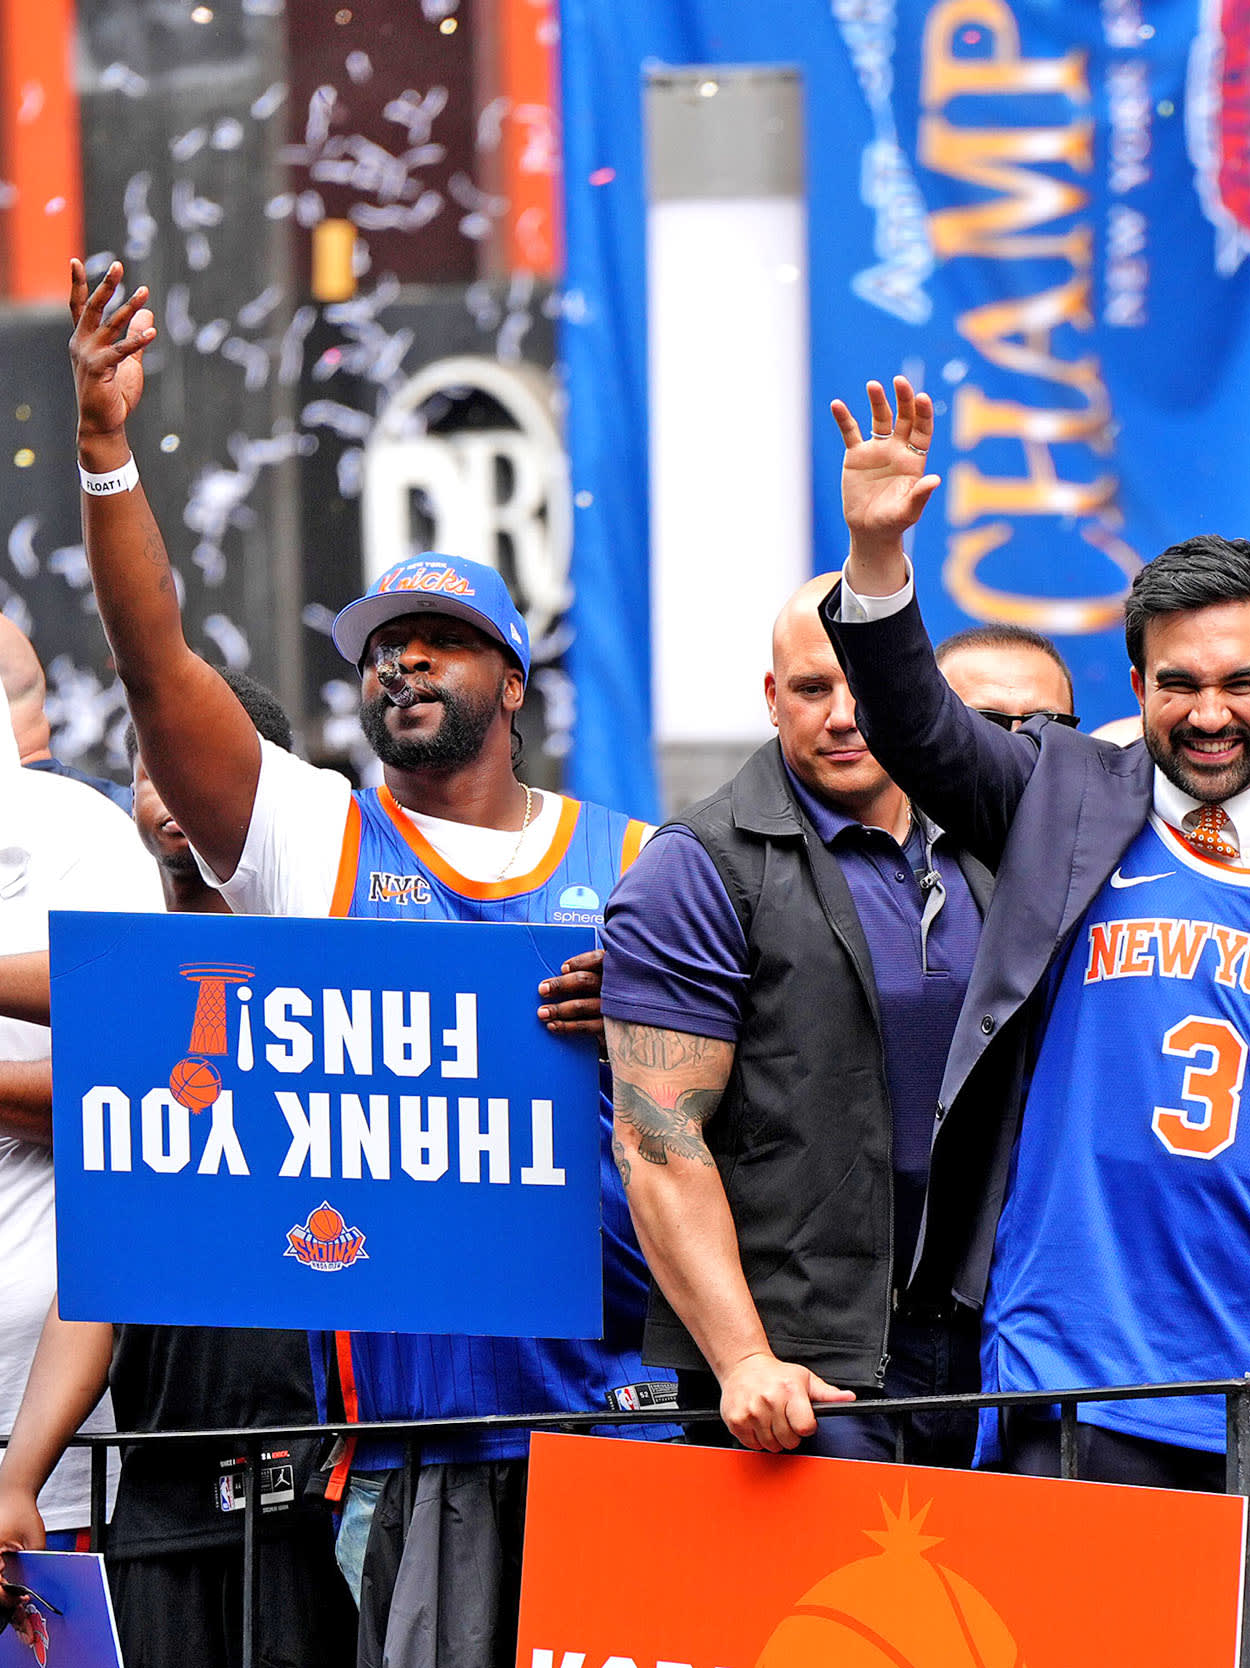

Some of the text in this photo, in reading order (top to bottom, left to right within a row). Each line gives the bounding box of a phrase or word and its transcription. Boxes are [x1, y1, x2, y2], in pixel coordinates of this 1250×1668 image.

[1104, 60, 1151, 194] YORK
[1103, 204, 1149, 328] NEW
[86, 480, 115, 492] FLOAT
[377, 567, 475, 596] Knicks
[369, 871, 431, 905] NYC
[553, 911, 605, 924] sphere
[1083, 917, 1212, 986] NEW
[237, 985, 479, 1079] FANS!
[1151, 1014, 1249, 1160] 3
[81, 1085, 566, 1186] THANK YOU
[290, 1234, 363, 1264] KNICKS
[640, 1391, 649, 1399] 52
